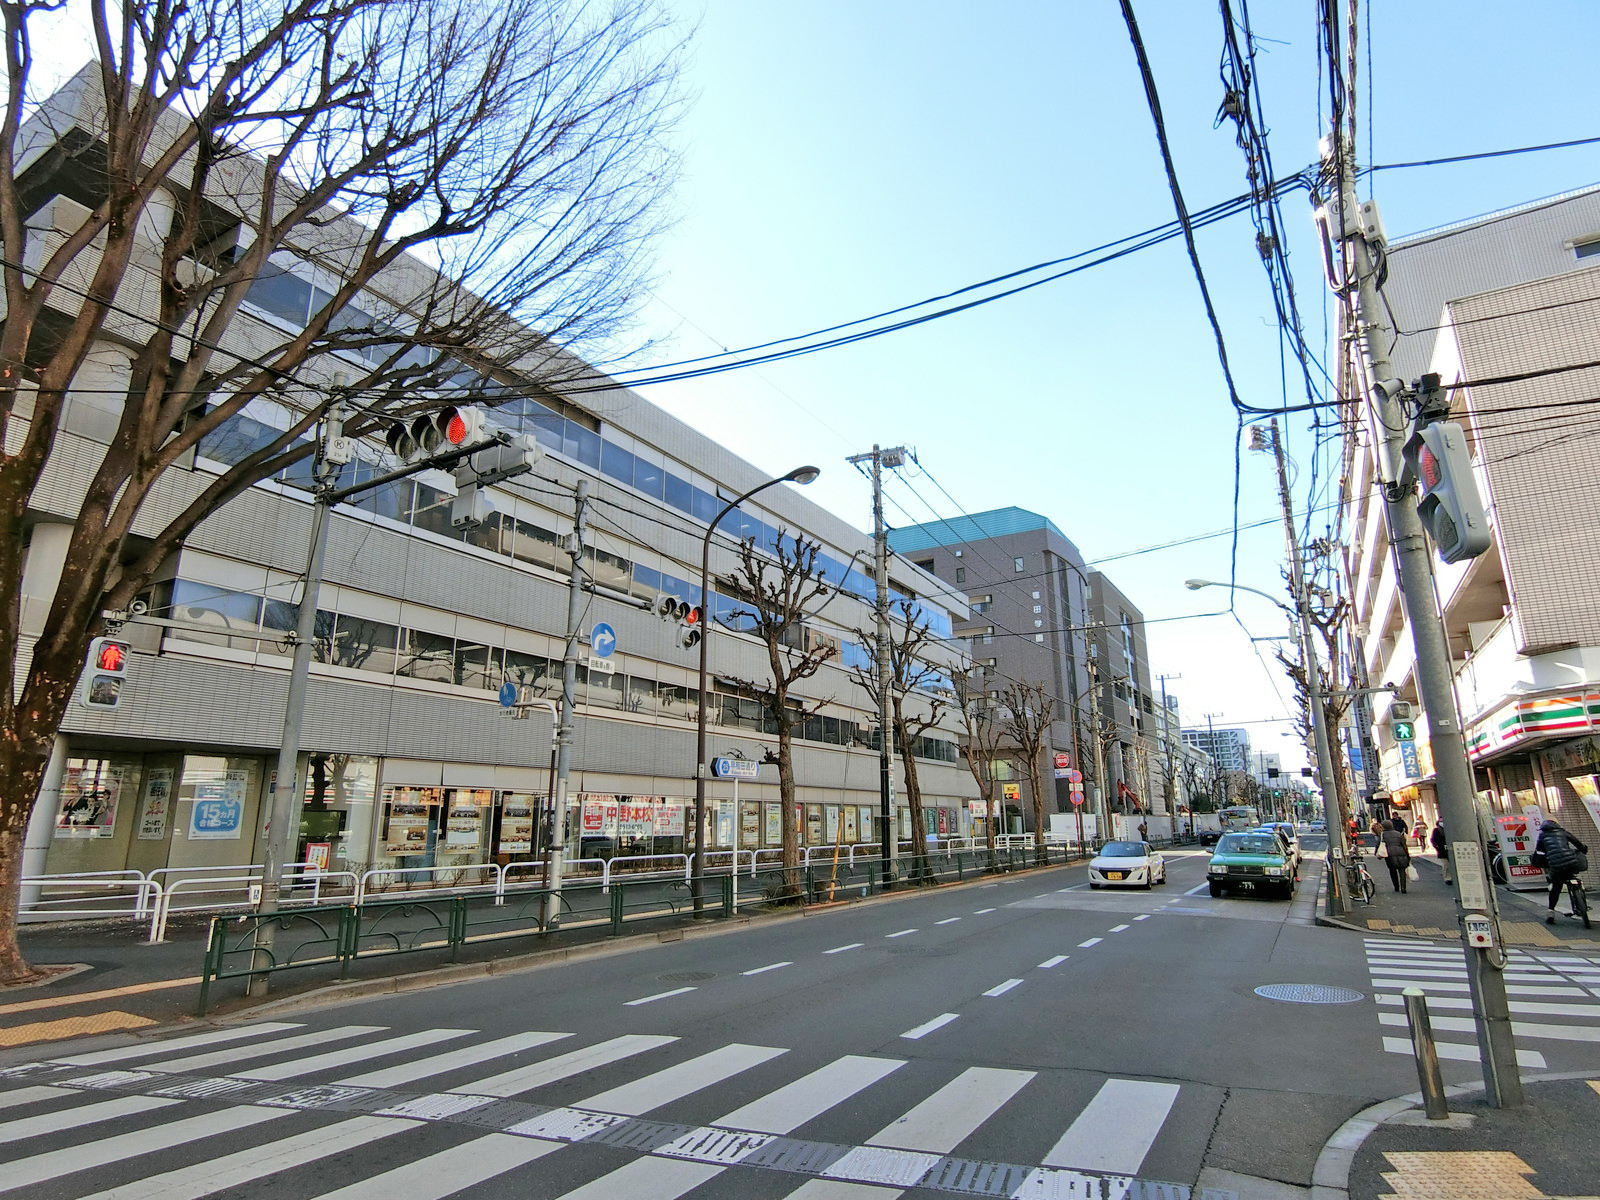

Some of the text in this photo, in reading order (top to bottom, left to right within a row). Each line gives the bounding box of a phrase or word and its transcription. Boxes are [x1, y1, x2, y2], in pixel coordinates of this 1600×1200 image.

[1404, 746, 1418, 775] メガネ
[606, 805, 653, 823] 中野本校
[1503, 823, 1527, 851] 7
